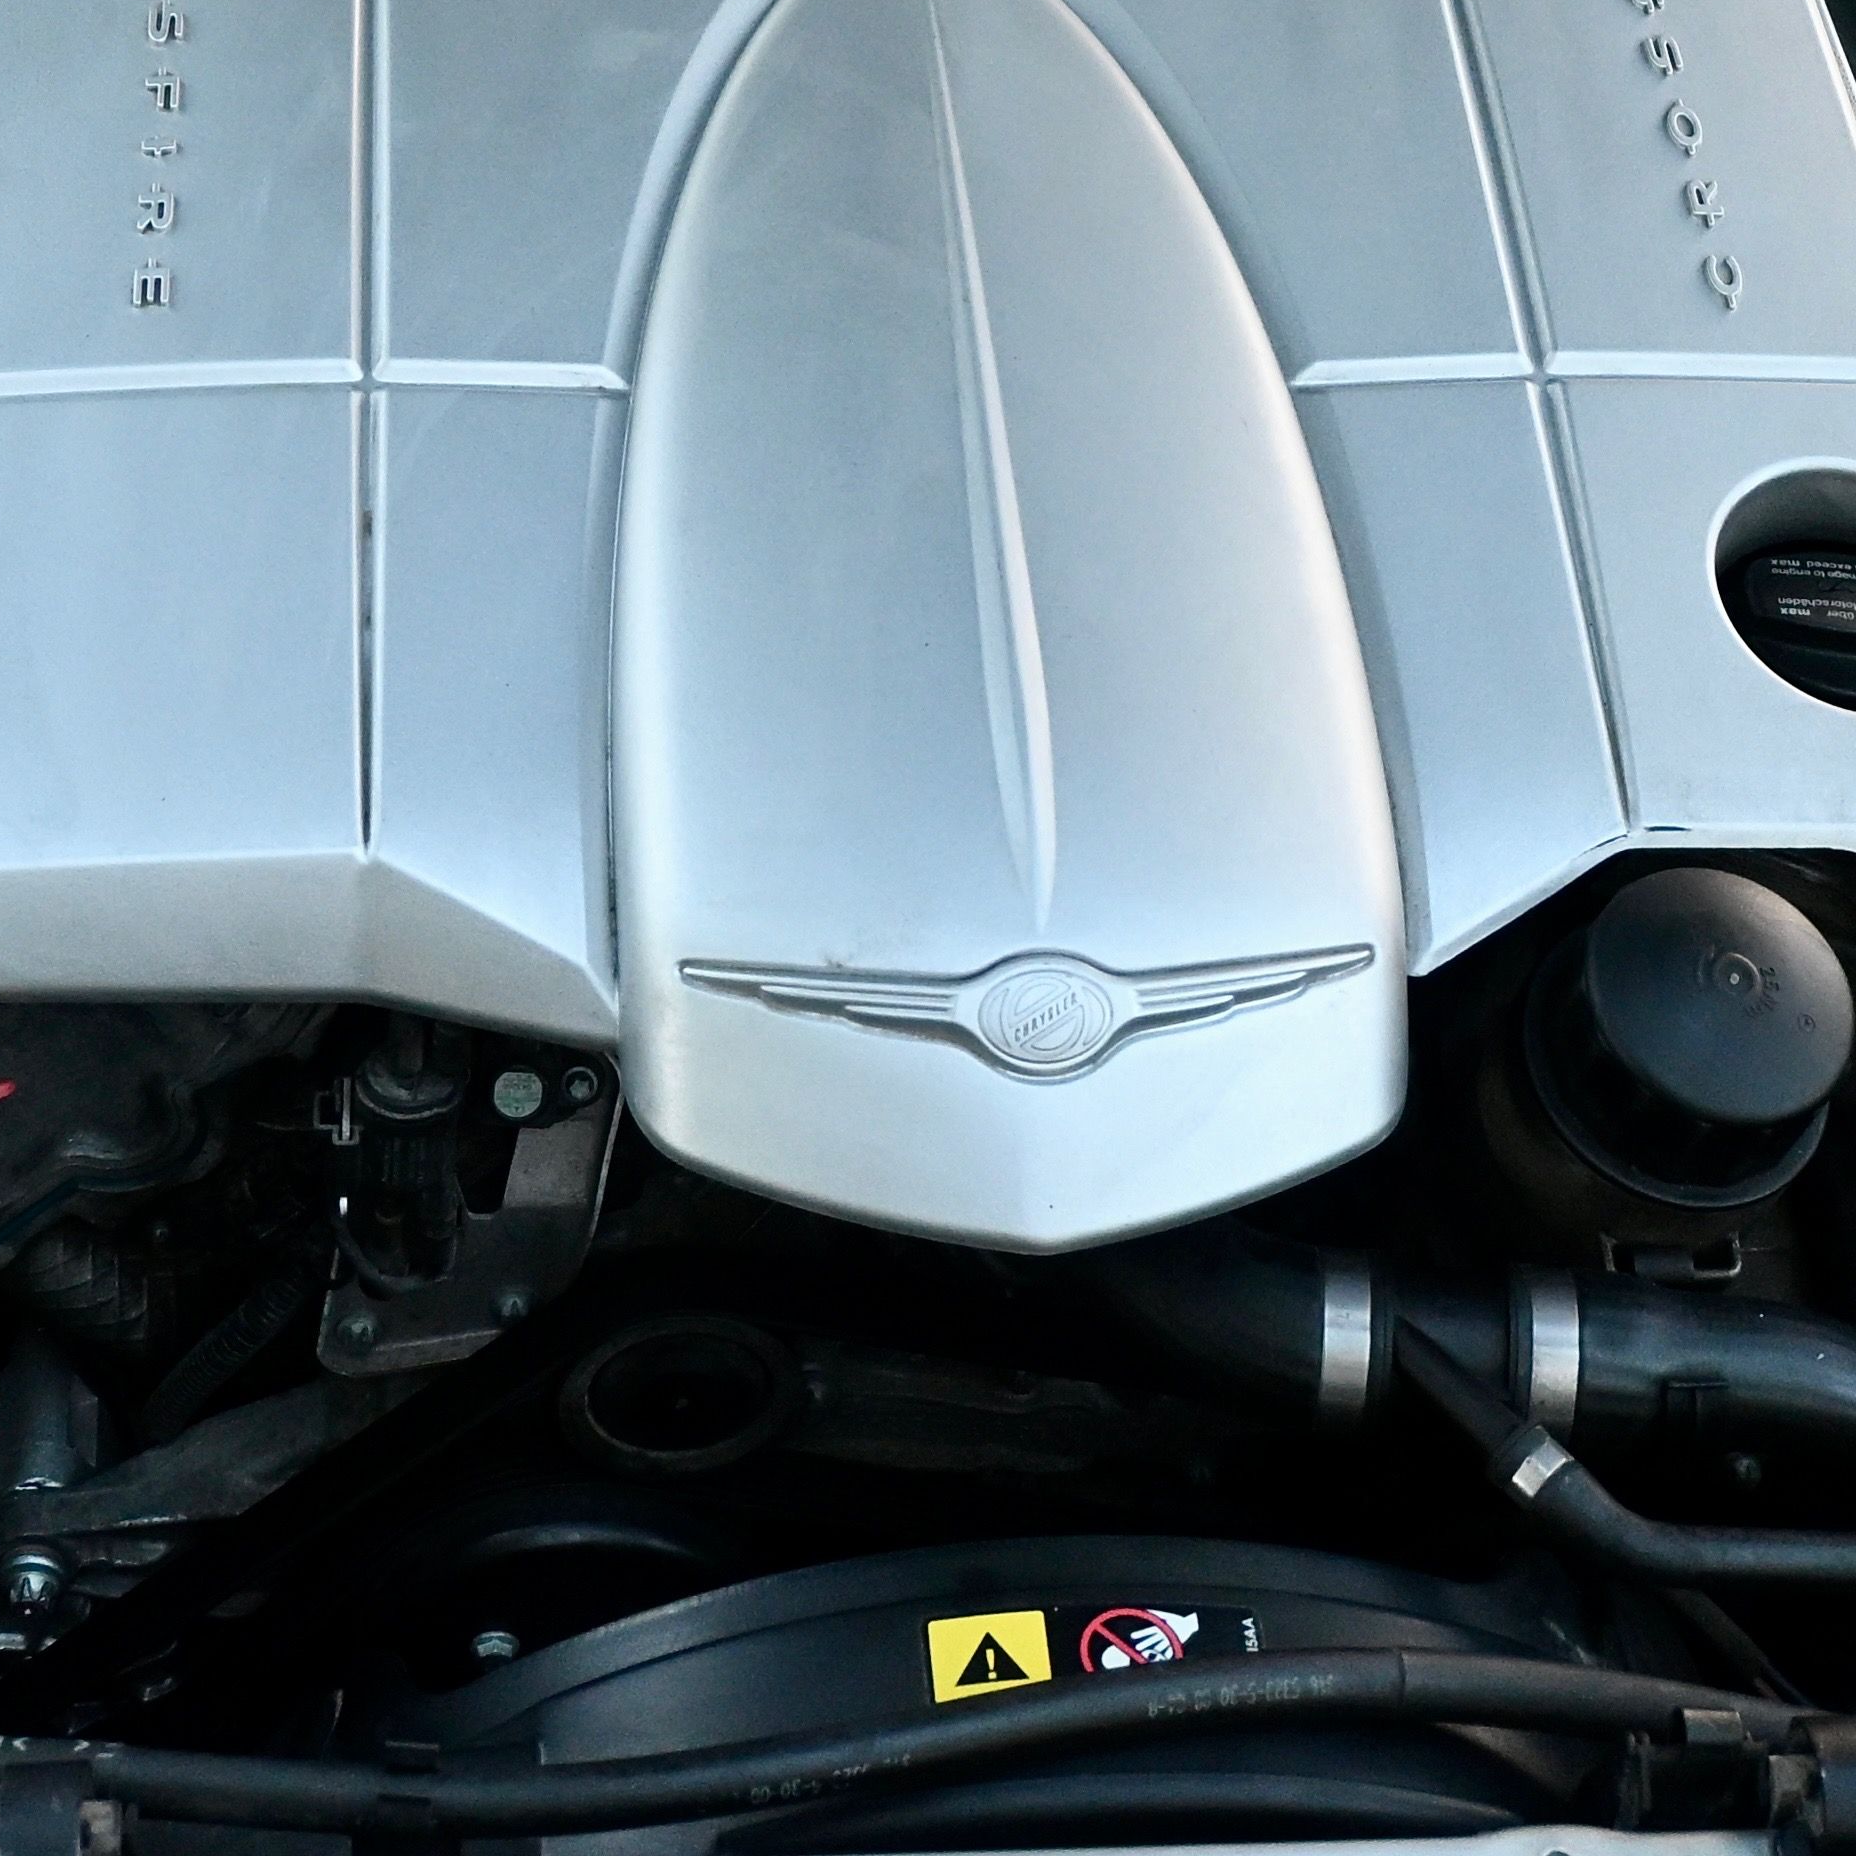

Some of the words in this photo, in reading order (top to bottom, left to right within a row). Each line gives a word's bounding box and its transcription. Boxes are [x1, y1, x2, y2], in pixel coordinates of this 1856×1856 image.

[1770, 557, 1801, 567] max
[1805, 559, 1852, 571] exceed
[1812, 569, 1826, 578] to
[1779, 606, 1811, 617] max
[1013, 991, 1079, 1044] CHRYSLER
